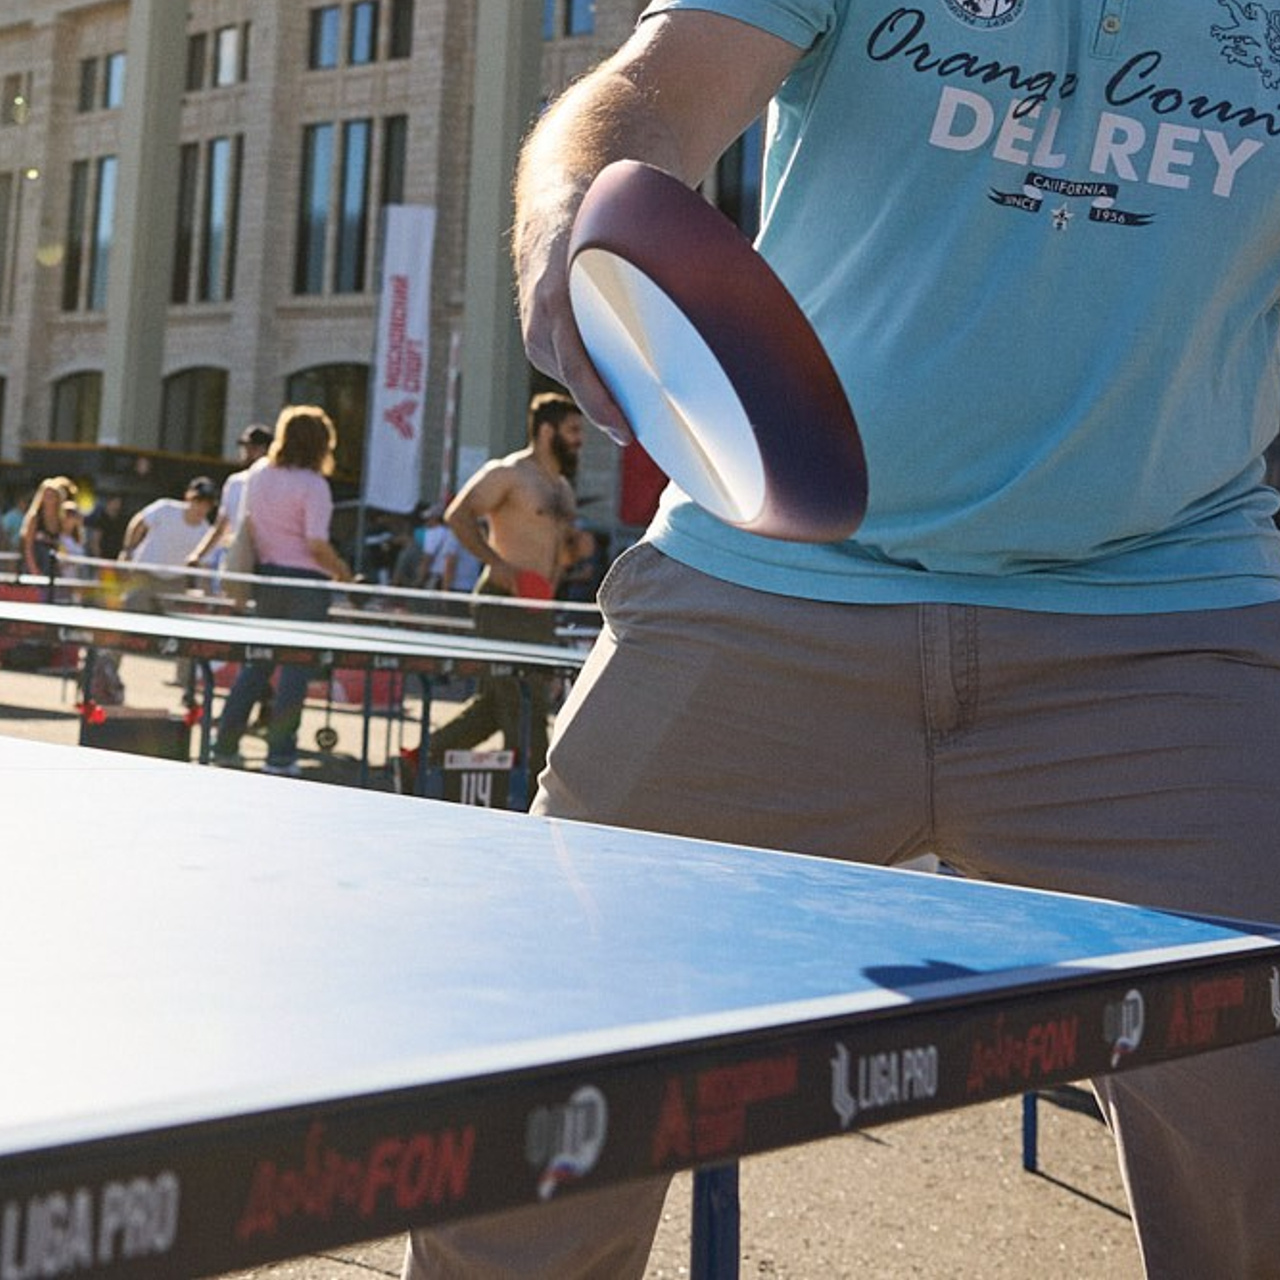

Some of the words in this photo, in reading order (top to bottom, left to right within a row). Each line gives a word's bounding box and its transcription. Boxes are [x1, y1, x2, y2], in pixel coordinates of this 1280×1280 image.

[866, 7, 1078, 120] Orange
[1105, 50, 1280, 136] Coun
[929, 85, 1068, 169] DEL
[1089, 111, 1265, 199] REY
[1004, 193, 1037, 211] SINCE
[1094, 209, 1126, 224] 1956
[1032, 175, 1109, 196] CALIFORNIA
[460, 771, 493, 808] 114
[858, 1052, 899, 1109] LIGA
[902, 1044, 939, 1101] PRO
[97, 1170, 181, 1263] PRO
